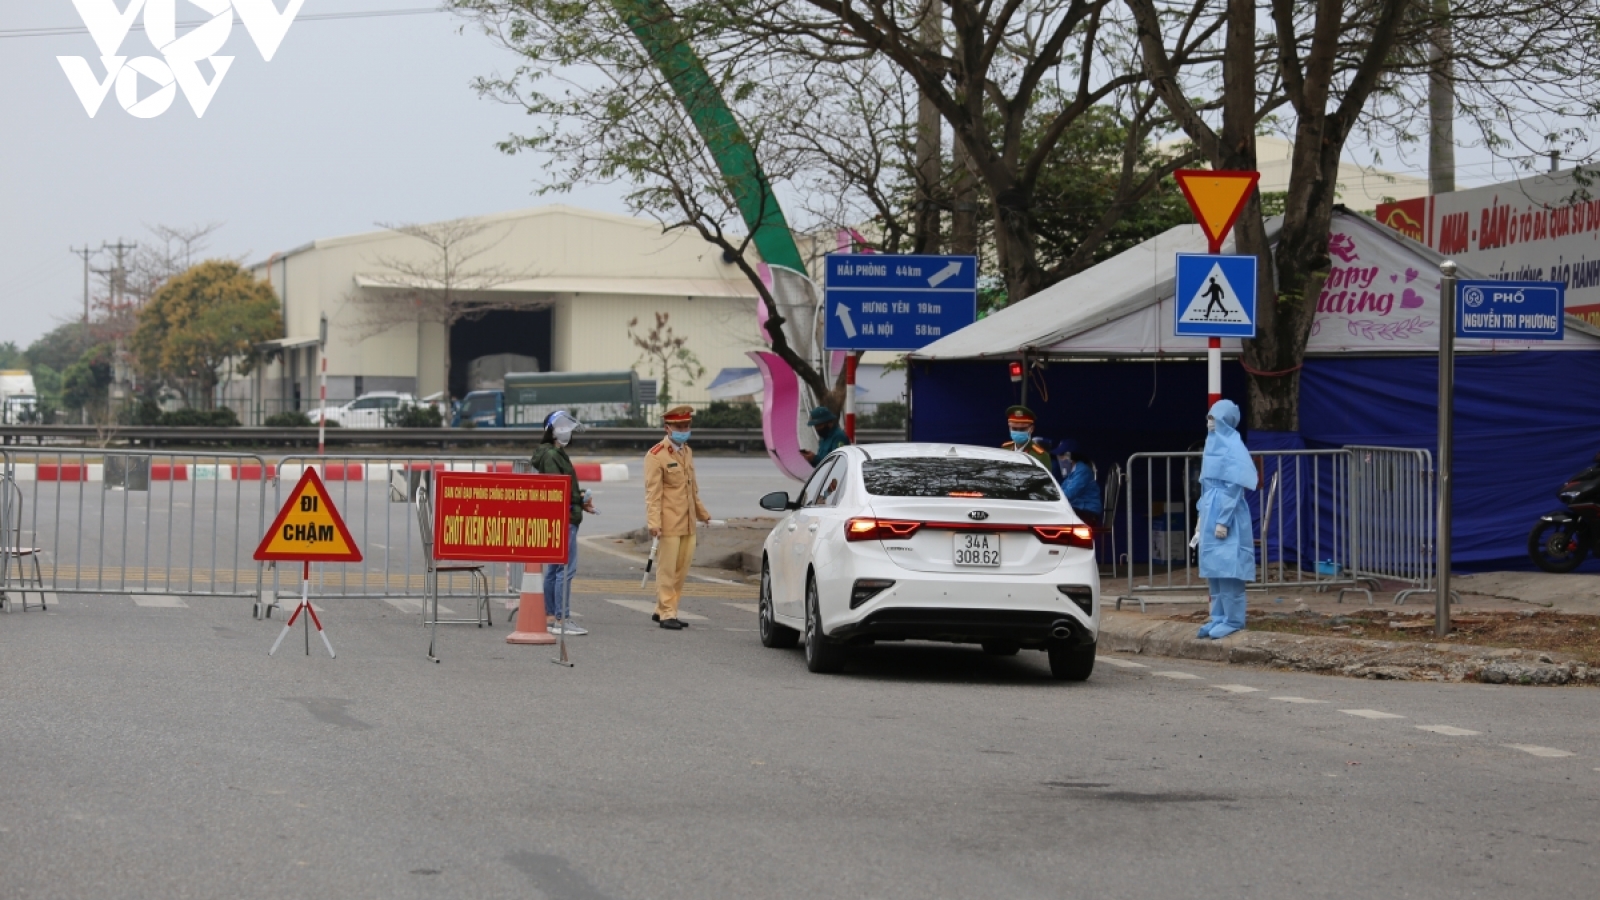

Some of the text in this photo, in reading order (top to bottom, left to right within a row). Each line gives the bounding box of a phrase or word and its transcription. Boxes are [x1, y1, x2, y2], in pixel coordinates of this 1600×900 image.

[1438, 211, 1469, 256] MUA
[1479, 194, 1510, 251] BÁN
[1549, 204, 1569, 241] QUA
[856, 262, 887, 277] PHÒNG
[1324, 266, 1379, 289] ppy
[1493, 288, 1525, 304] PHỐ
[862, 301, 888, 314] HƯNG
[892, 300, 910, 314] YÊN
[862, 321, 875, 336] HÀ
[878, 321, 894, 338] NỘI
[1503, 314, 1517, 329] TRI
[1519, 313, 1557, 330] PHƯƠNG
[300, 495, 319, 512] ĐI
[283, 521, 334, 544] CHẬM
[444, 503, 561, 554] CHỐT KIỂM SOÁT DỊCH COVID-19
[965, 534, 989, 549] 34A
[956, 549, 999, 565] 308.62
